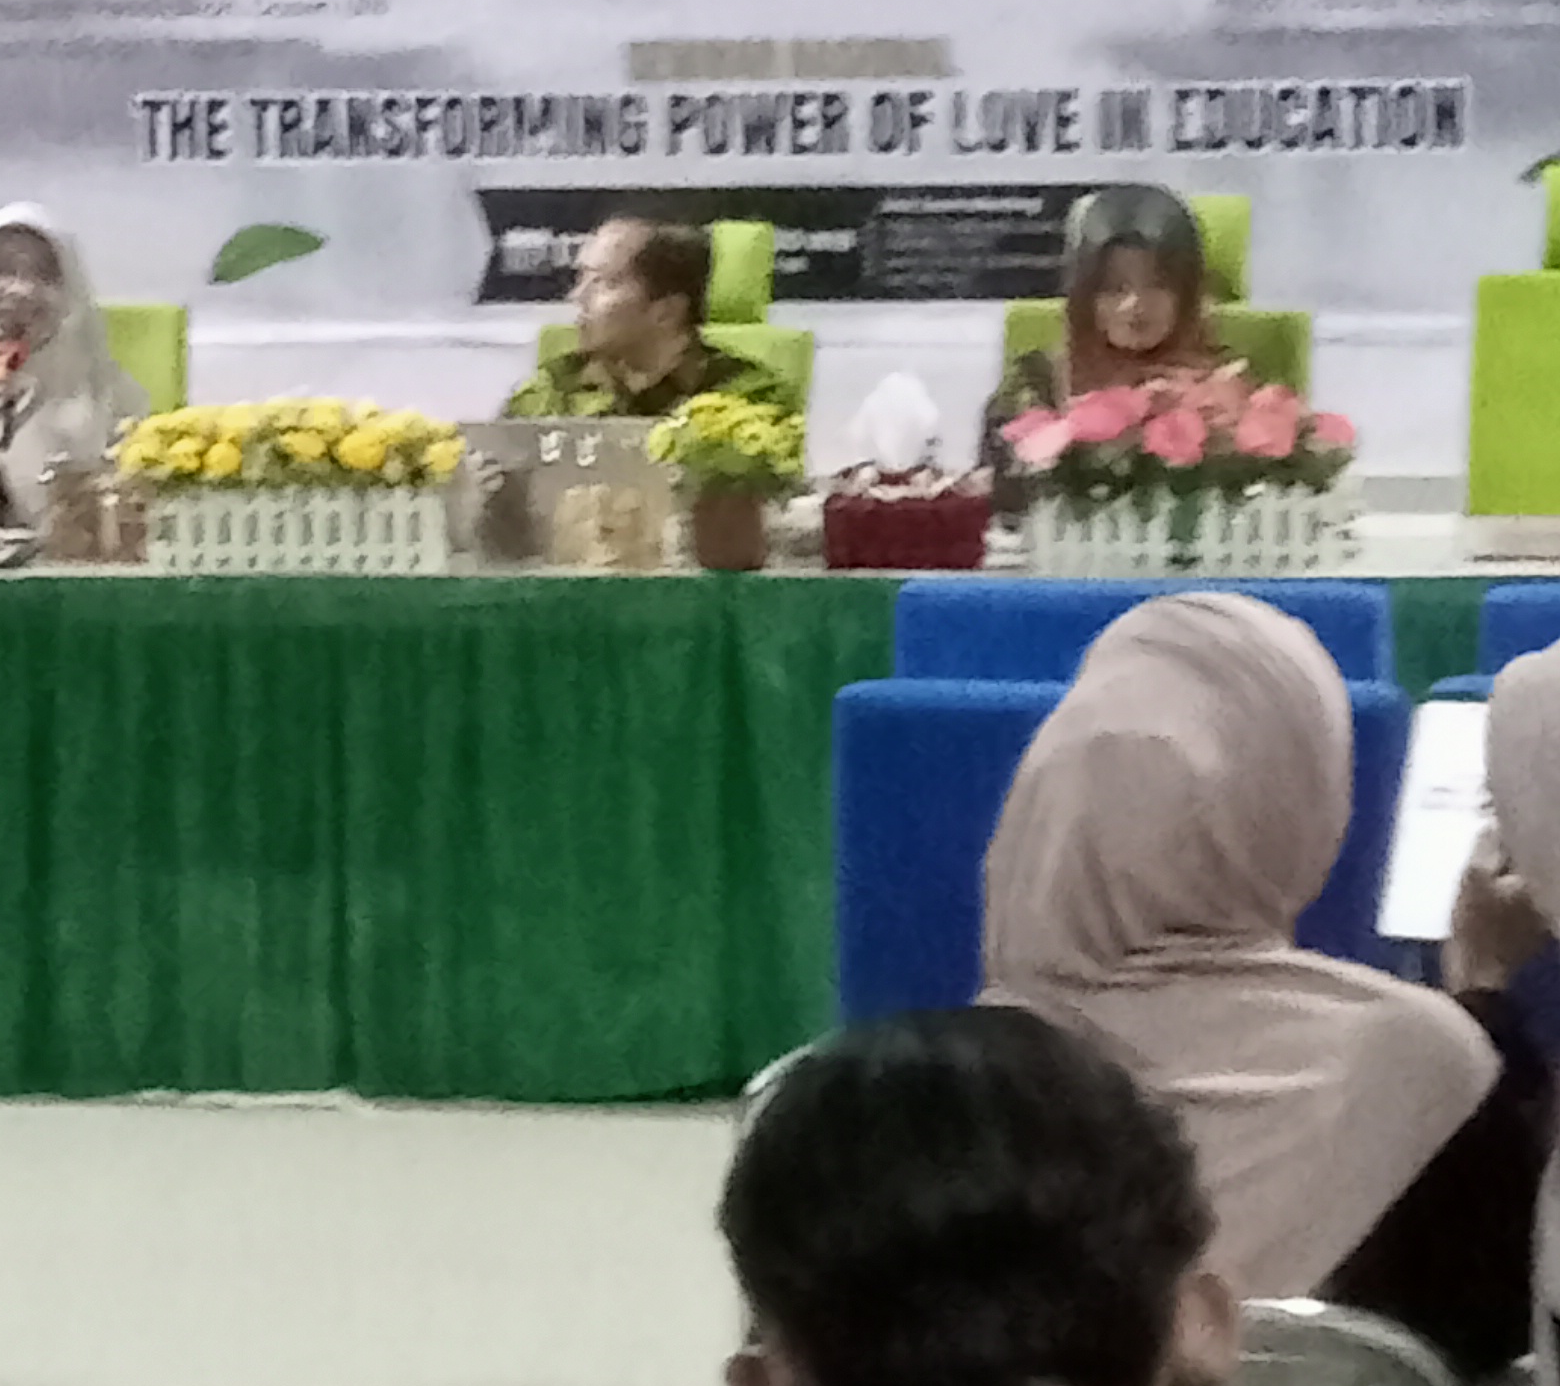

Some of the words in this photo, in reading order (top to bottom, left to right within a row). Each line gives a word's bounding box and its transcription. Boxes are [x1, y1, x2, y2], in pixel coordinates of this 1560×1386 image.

[140, 96, 230, 160] THE
[248, 95, 647, 159] TRANSFORMING
[665, 91, 849, 157] POWER
[870, 89, 935, 155] OF
[951, 88, 1081, 153] LOVE
[1099, 87, 1153, 151] IN
[1166, 84, 1466, 151] EDUCATION
